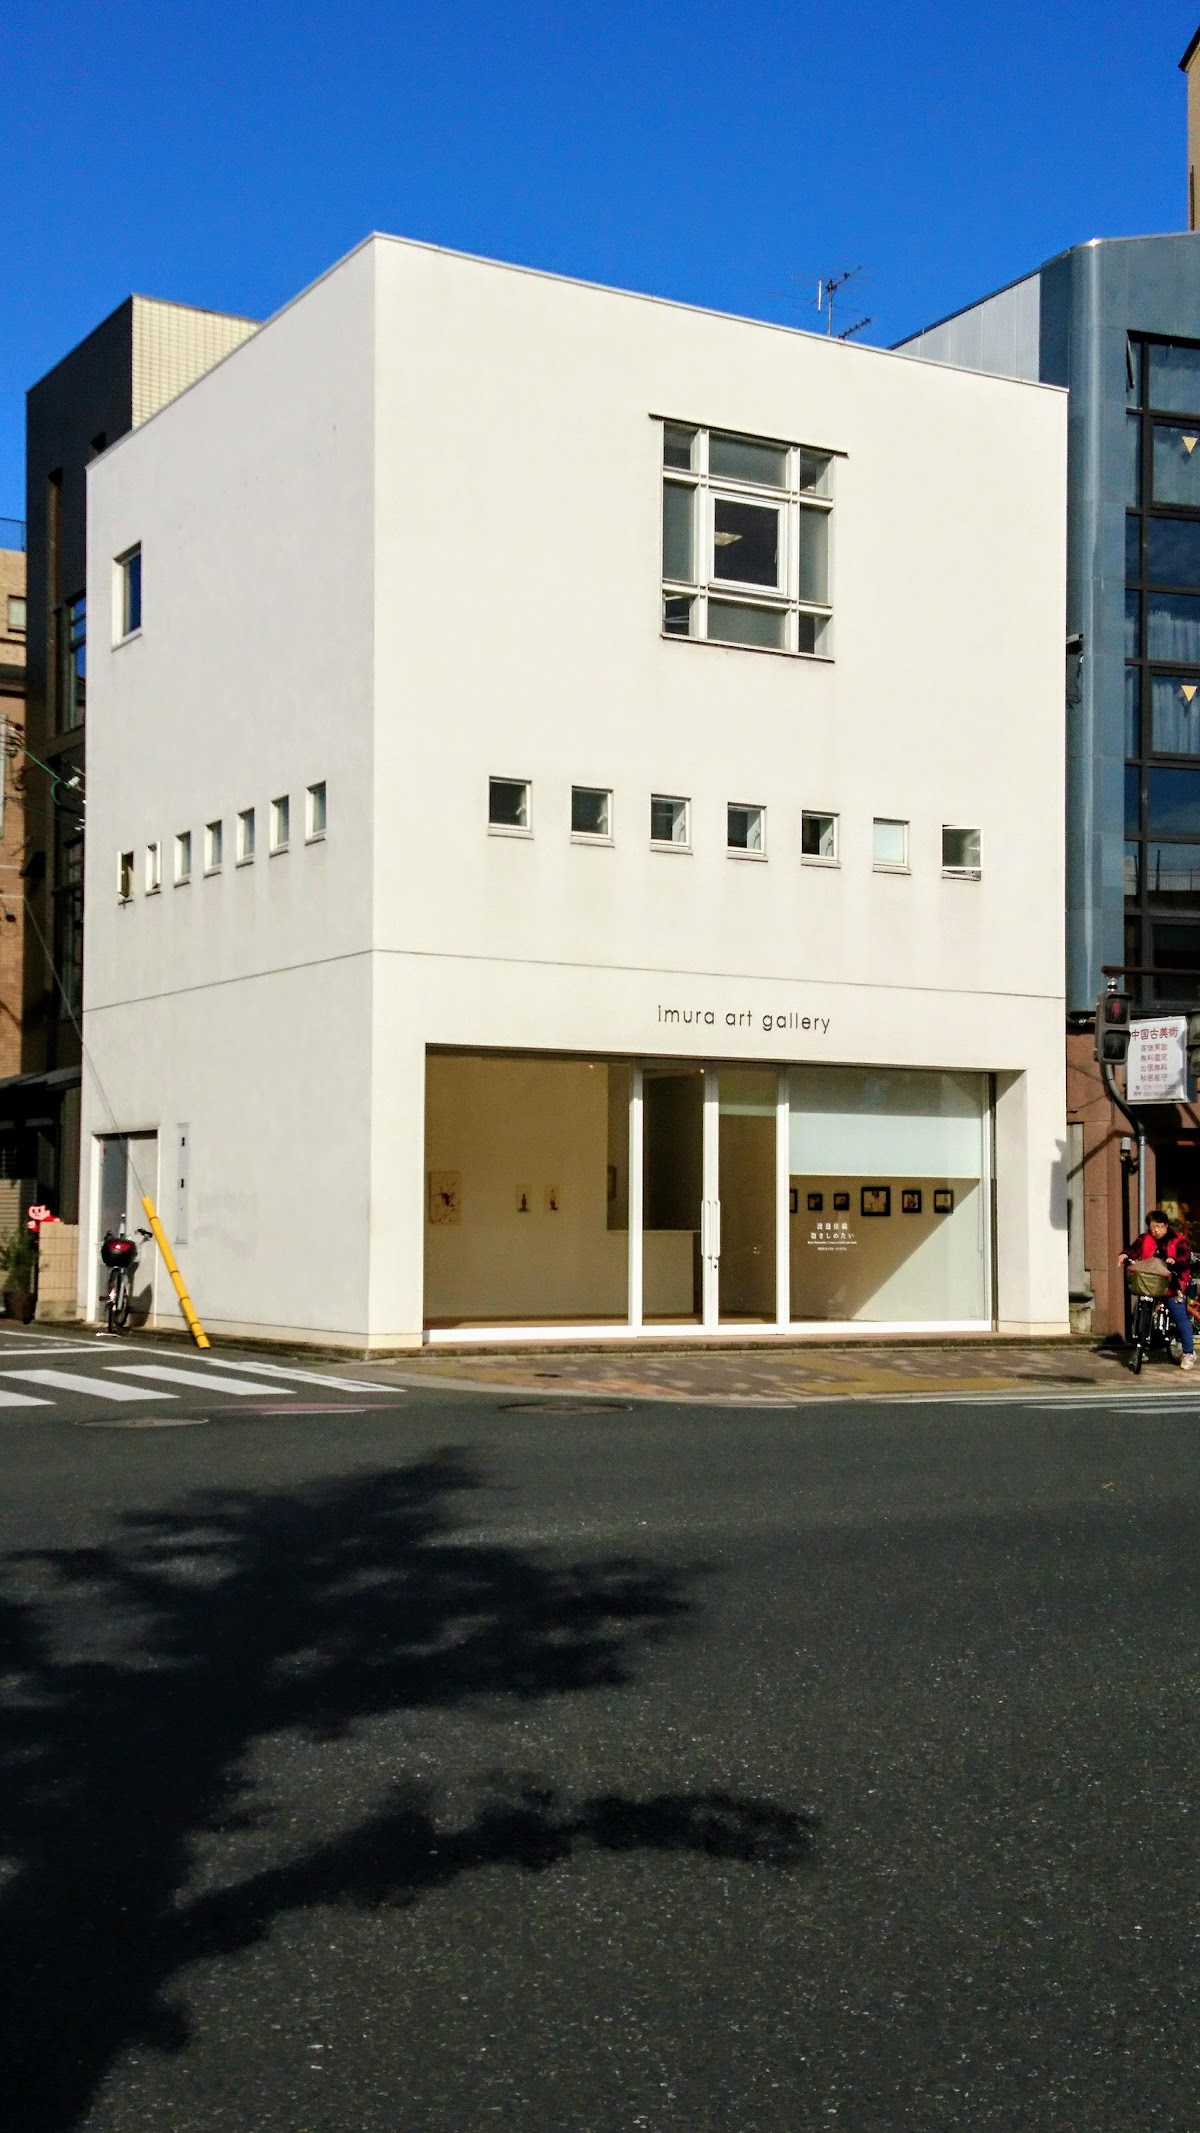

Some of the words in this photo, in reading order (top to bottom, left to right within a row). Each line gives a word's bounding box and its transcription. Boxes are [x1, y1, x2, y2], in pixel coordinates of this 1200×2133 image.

[657, 1004, 715, 1025] imura
[725, 1010, 753, 1027] art
[762, 1012, 831, 1034] gallery
[1131, 1026, 1179, 1041] 中国古美術
